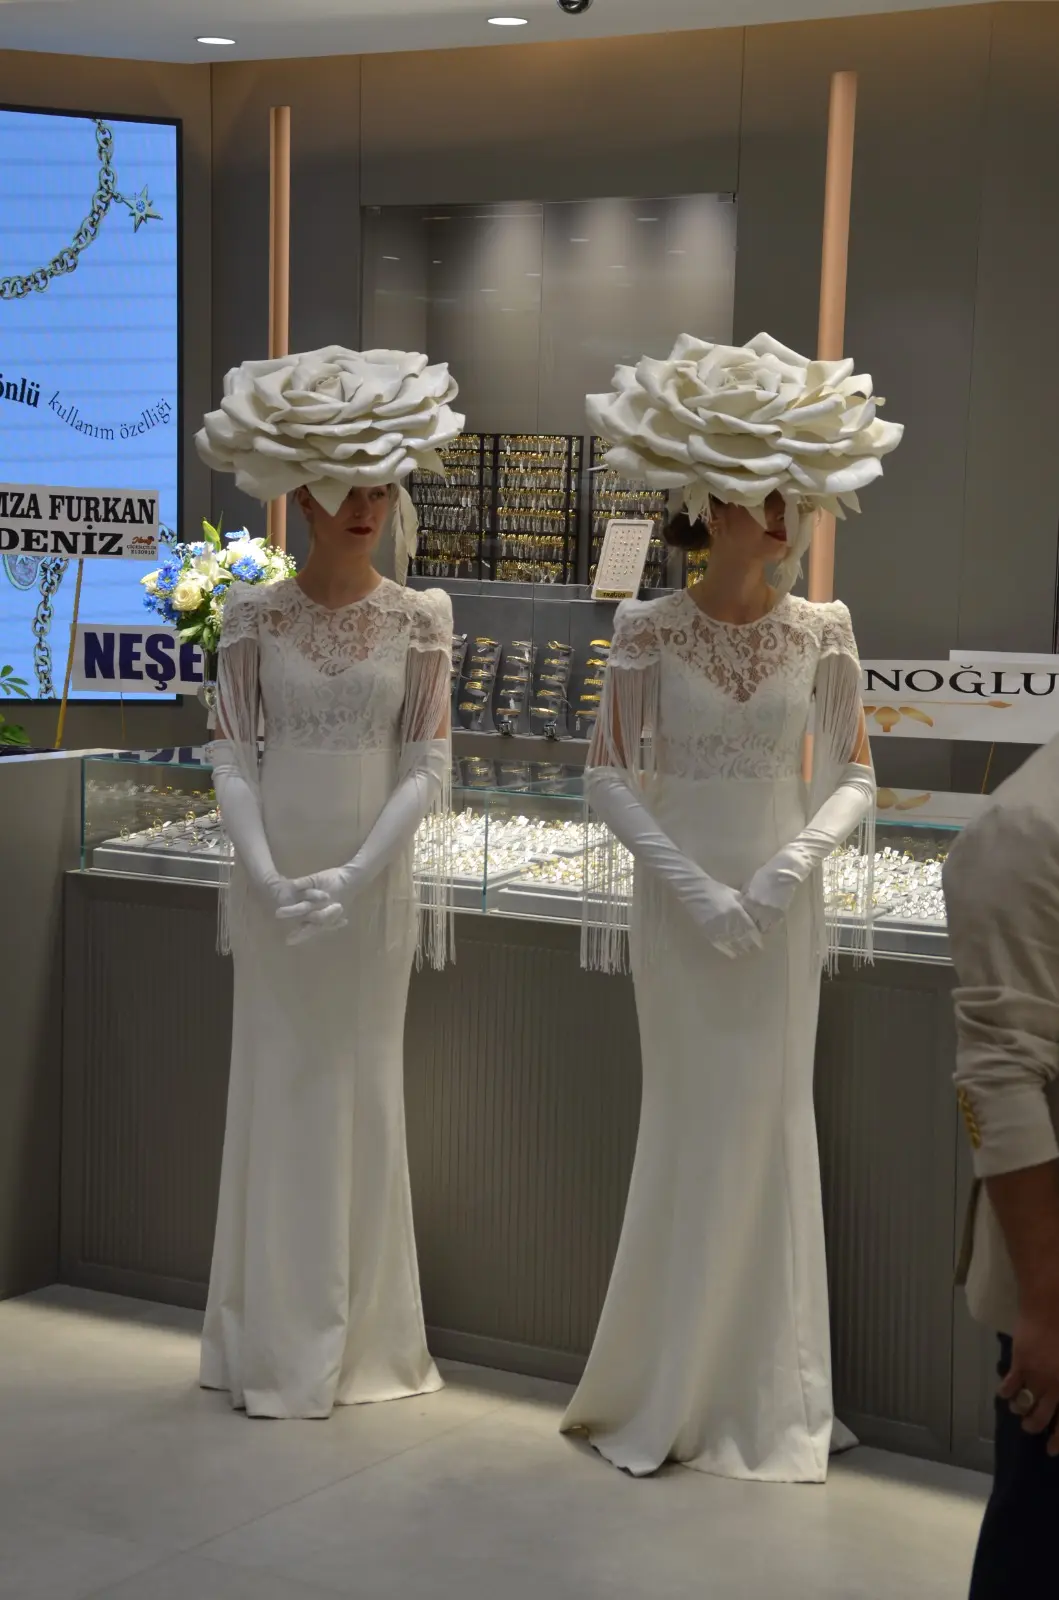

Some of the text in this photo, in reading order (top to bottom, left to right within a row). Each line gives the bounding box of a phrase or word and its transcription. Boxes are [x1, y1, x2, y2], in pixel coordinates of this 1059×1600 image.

[48, 391, 114, 440] kullanım
[119, 398, 172, 439] özelliği
[49, 494, 155, 525] FURKAN
[0, 524, 123, 555] DENİZ
[84, 632, 203, 691] NEŞE
[864, 665, 1058, 697] NOĞLU
